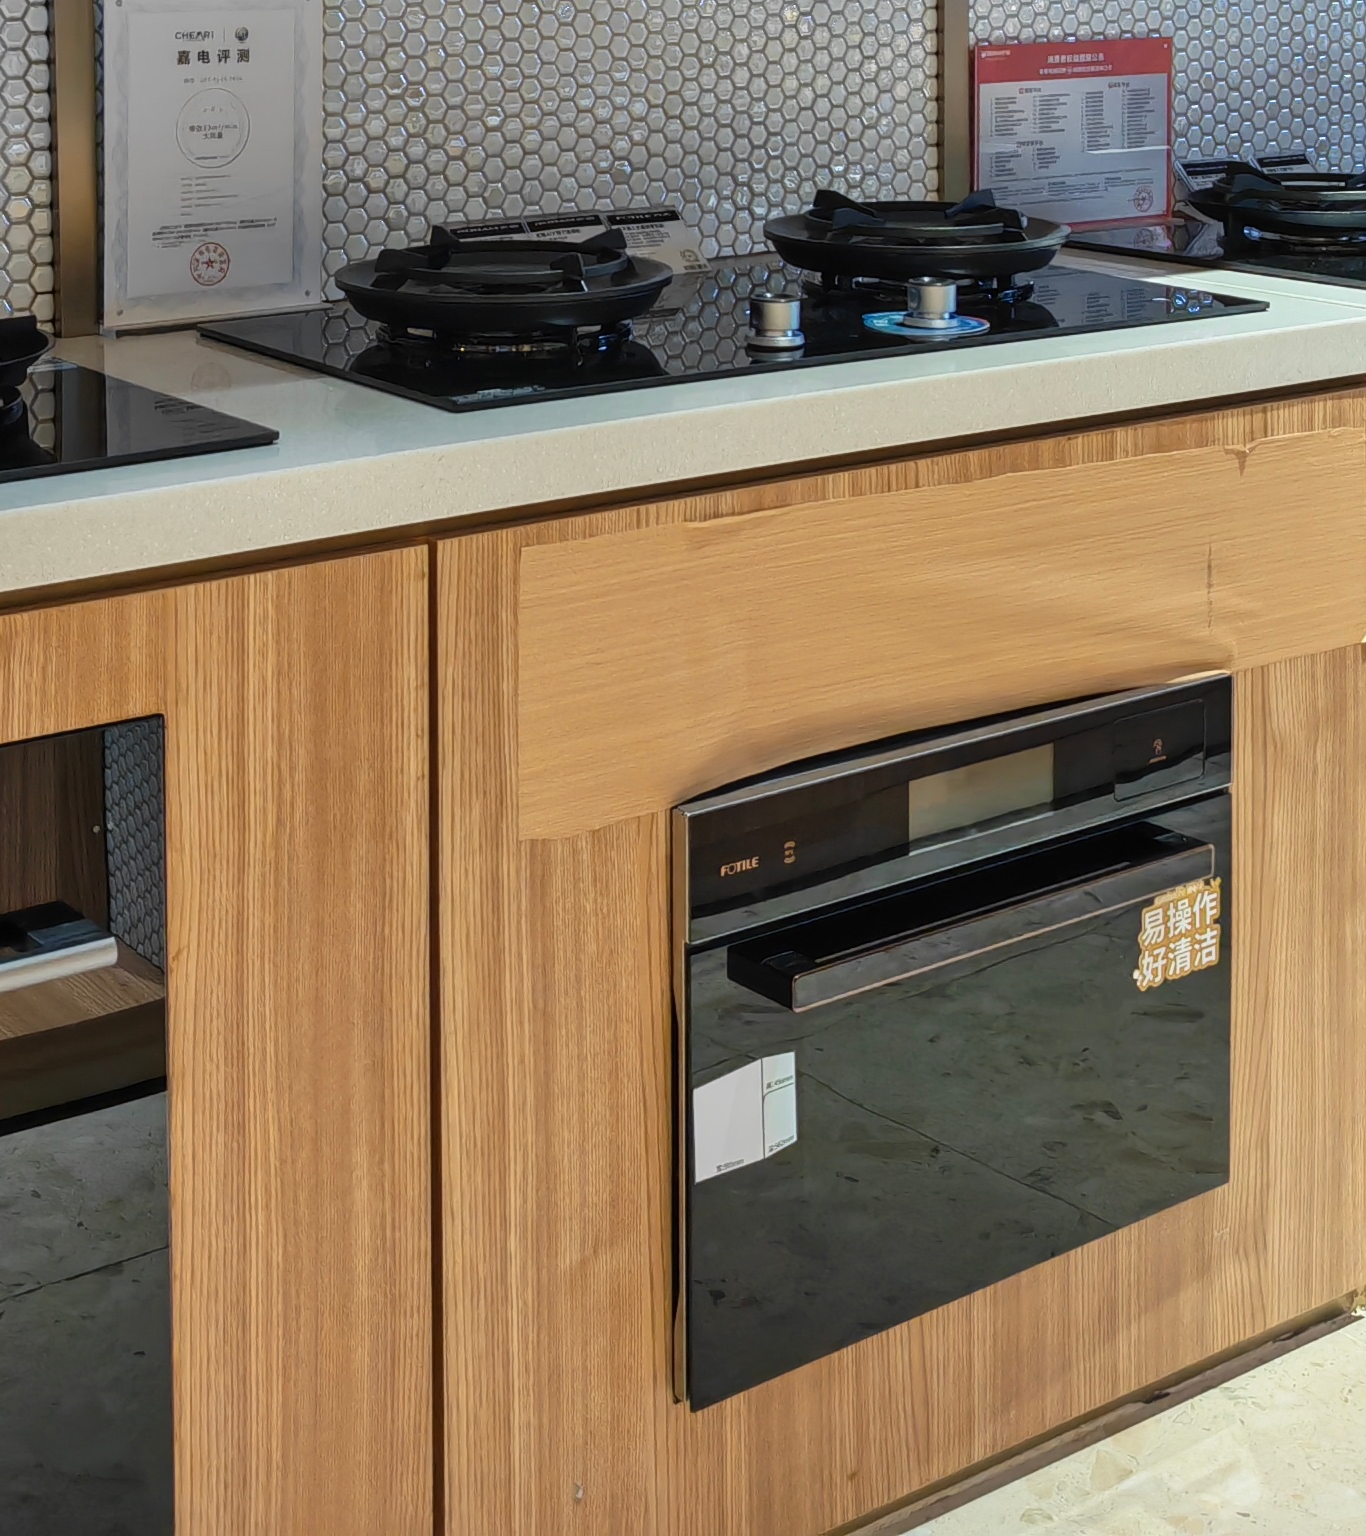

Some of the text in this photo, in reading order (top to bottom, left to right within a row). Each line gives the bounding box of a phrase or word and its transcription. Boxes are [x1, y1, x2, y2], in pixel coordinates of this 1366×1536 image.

[720, 855, 760, 877] FOTILE
[1141, 890, 1218, 947] 易操作
[1141, 927, 1218, 987] 好清洁
